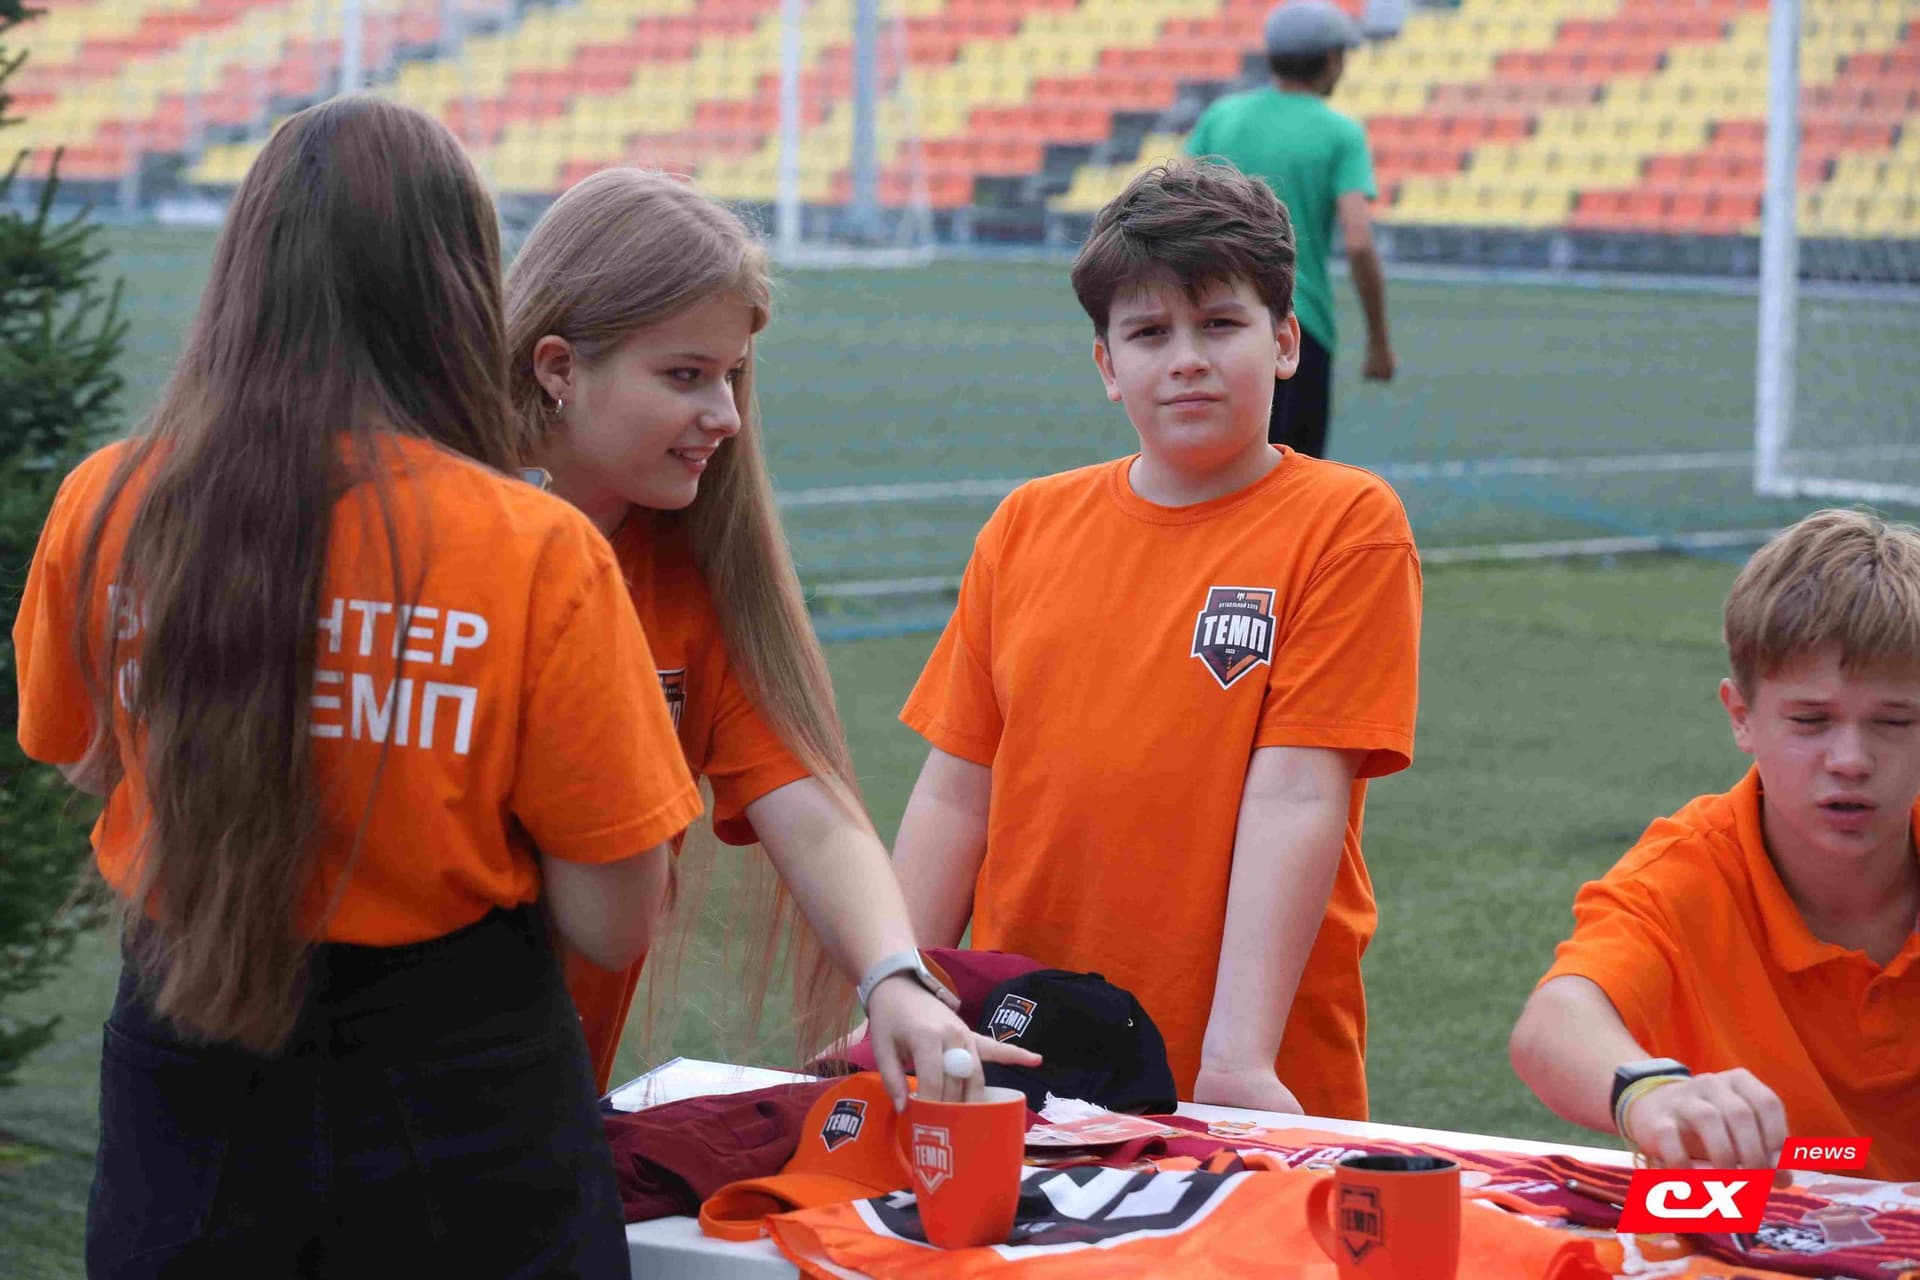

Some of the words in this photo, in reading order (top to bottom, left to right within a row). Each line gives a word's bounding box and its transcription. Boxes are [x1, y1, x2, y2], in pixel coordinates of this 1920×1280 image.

[1202, 614, 1268, 653] ТЕМП
[309, 670, 478, 756] ЕМП
[994, 1008, 1027, 1031] ТЕМП
[826, 1113, 860, 1135] ТЕМП
[914, 1144, 948, 1171] ТЕМП
